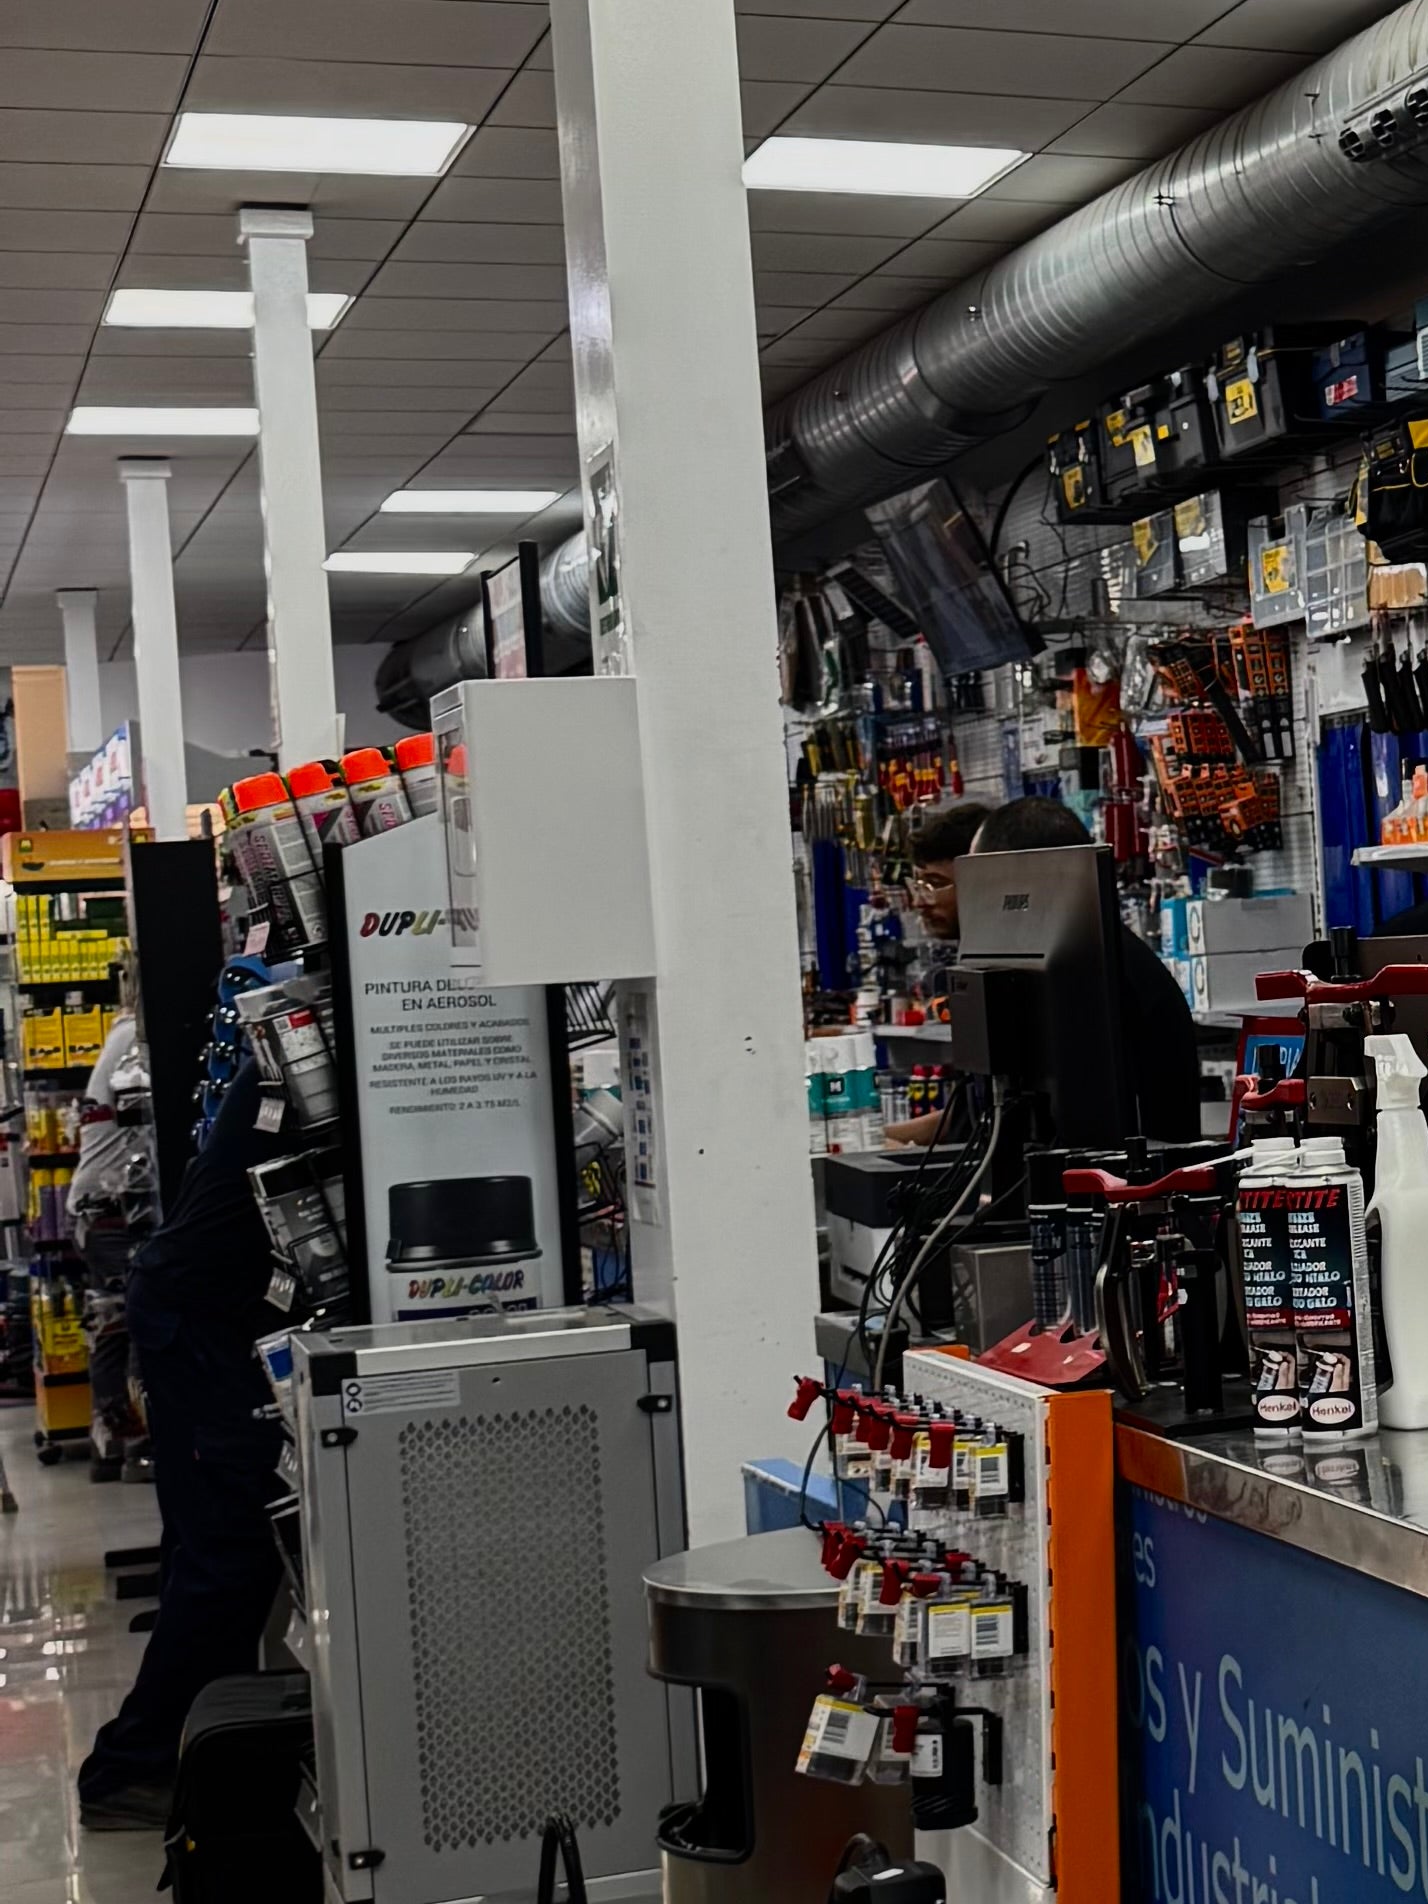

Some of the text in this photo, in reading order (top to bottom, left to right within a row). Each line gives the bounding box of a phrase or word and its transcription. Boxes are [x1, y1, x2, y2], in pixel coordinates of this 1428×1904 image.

[365, 979, 432, 995] PINTURA
[402, 994, 497, 1011] EN AEROSOL
[408, 1269, 525, 1299] DUPLI-COLOR
[1260, 1399, 1297, 1414] Henkel
[1311, 1403, 1352, 1417] Henkel
[1178, 1661, 1203, 1795] y
